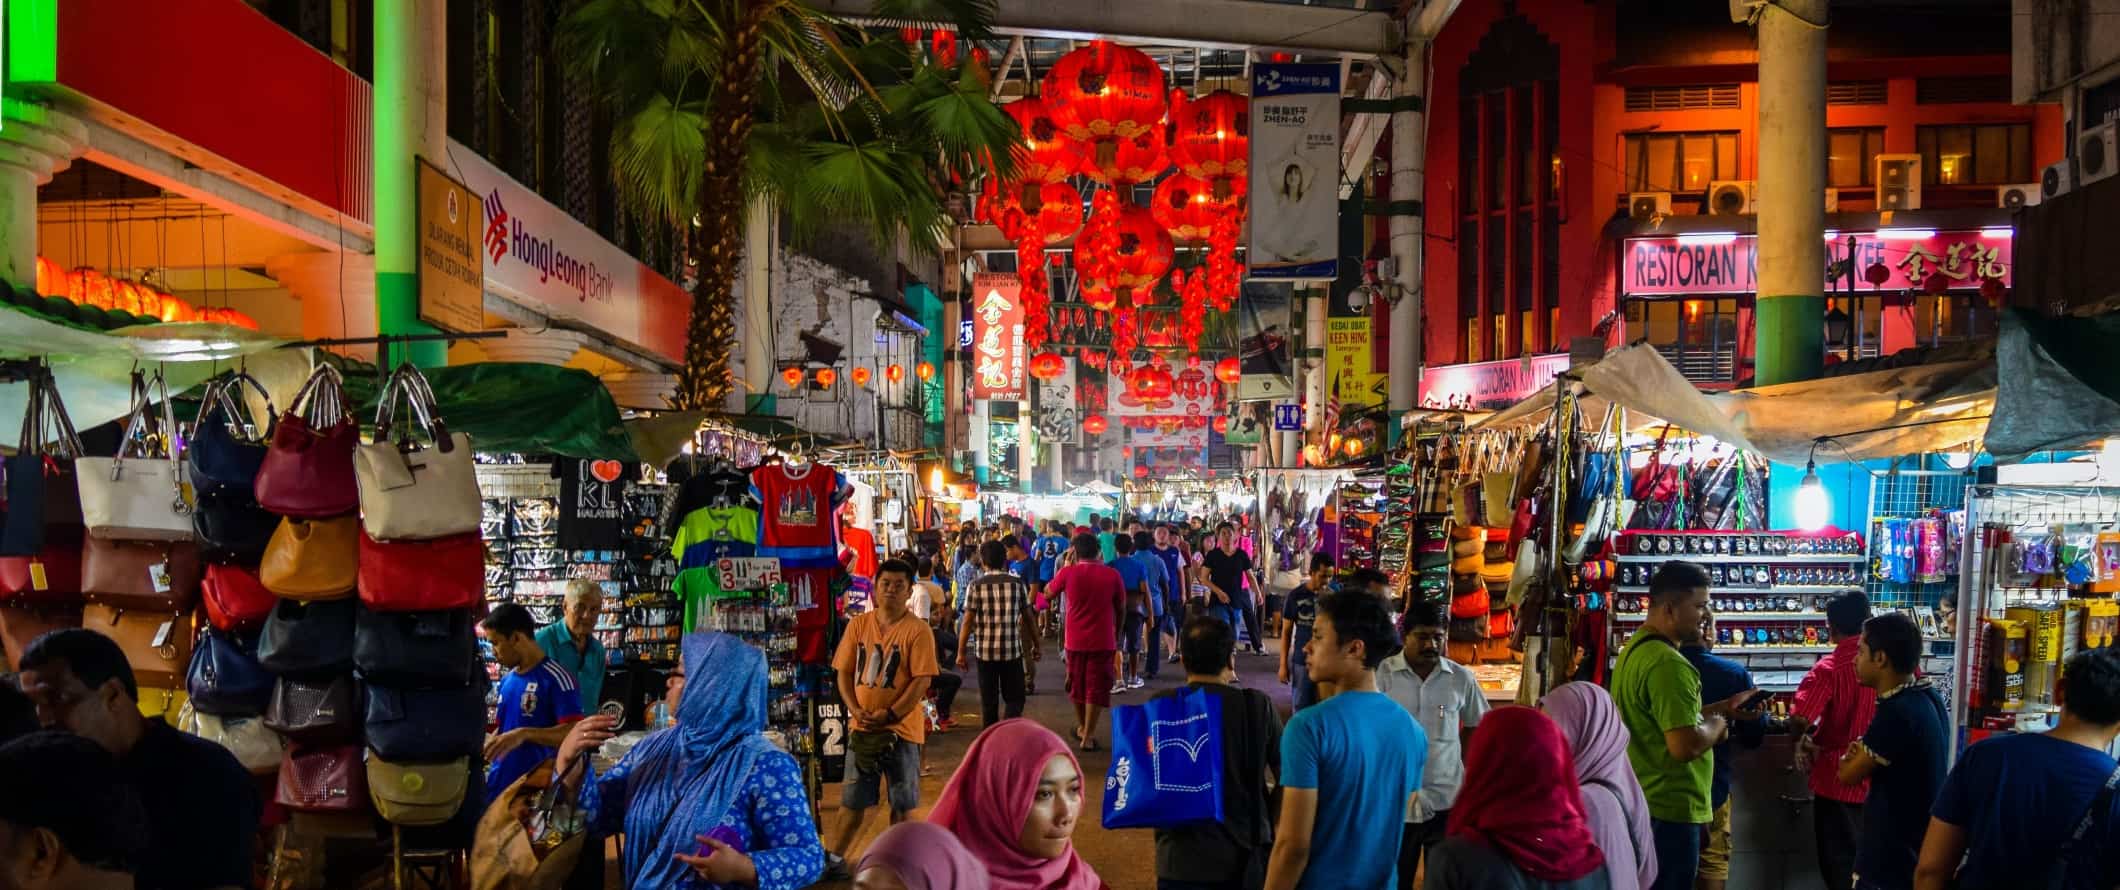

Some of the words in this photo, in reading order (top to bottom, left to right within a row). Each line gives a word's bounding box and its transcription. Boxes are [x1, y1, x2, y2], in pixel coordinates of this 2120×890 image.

[1263, 114, 1306, 124] ZHEN-AO
[1634, 245, 1736, 288] RESTORAN
[587, 260, 615, 305] Bank
[1350, 332, 1368, 344] HING
[577, 481, 617, 508] KL
[722, 572, 736, 590] 3
[2038, 634, 2048, 661] SPEED
[818, 703, 842, 718] USA
[820, 718, 845, 756] 2
